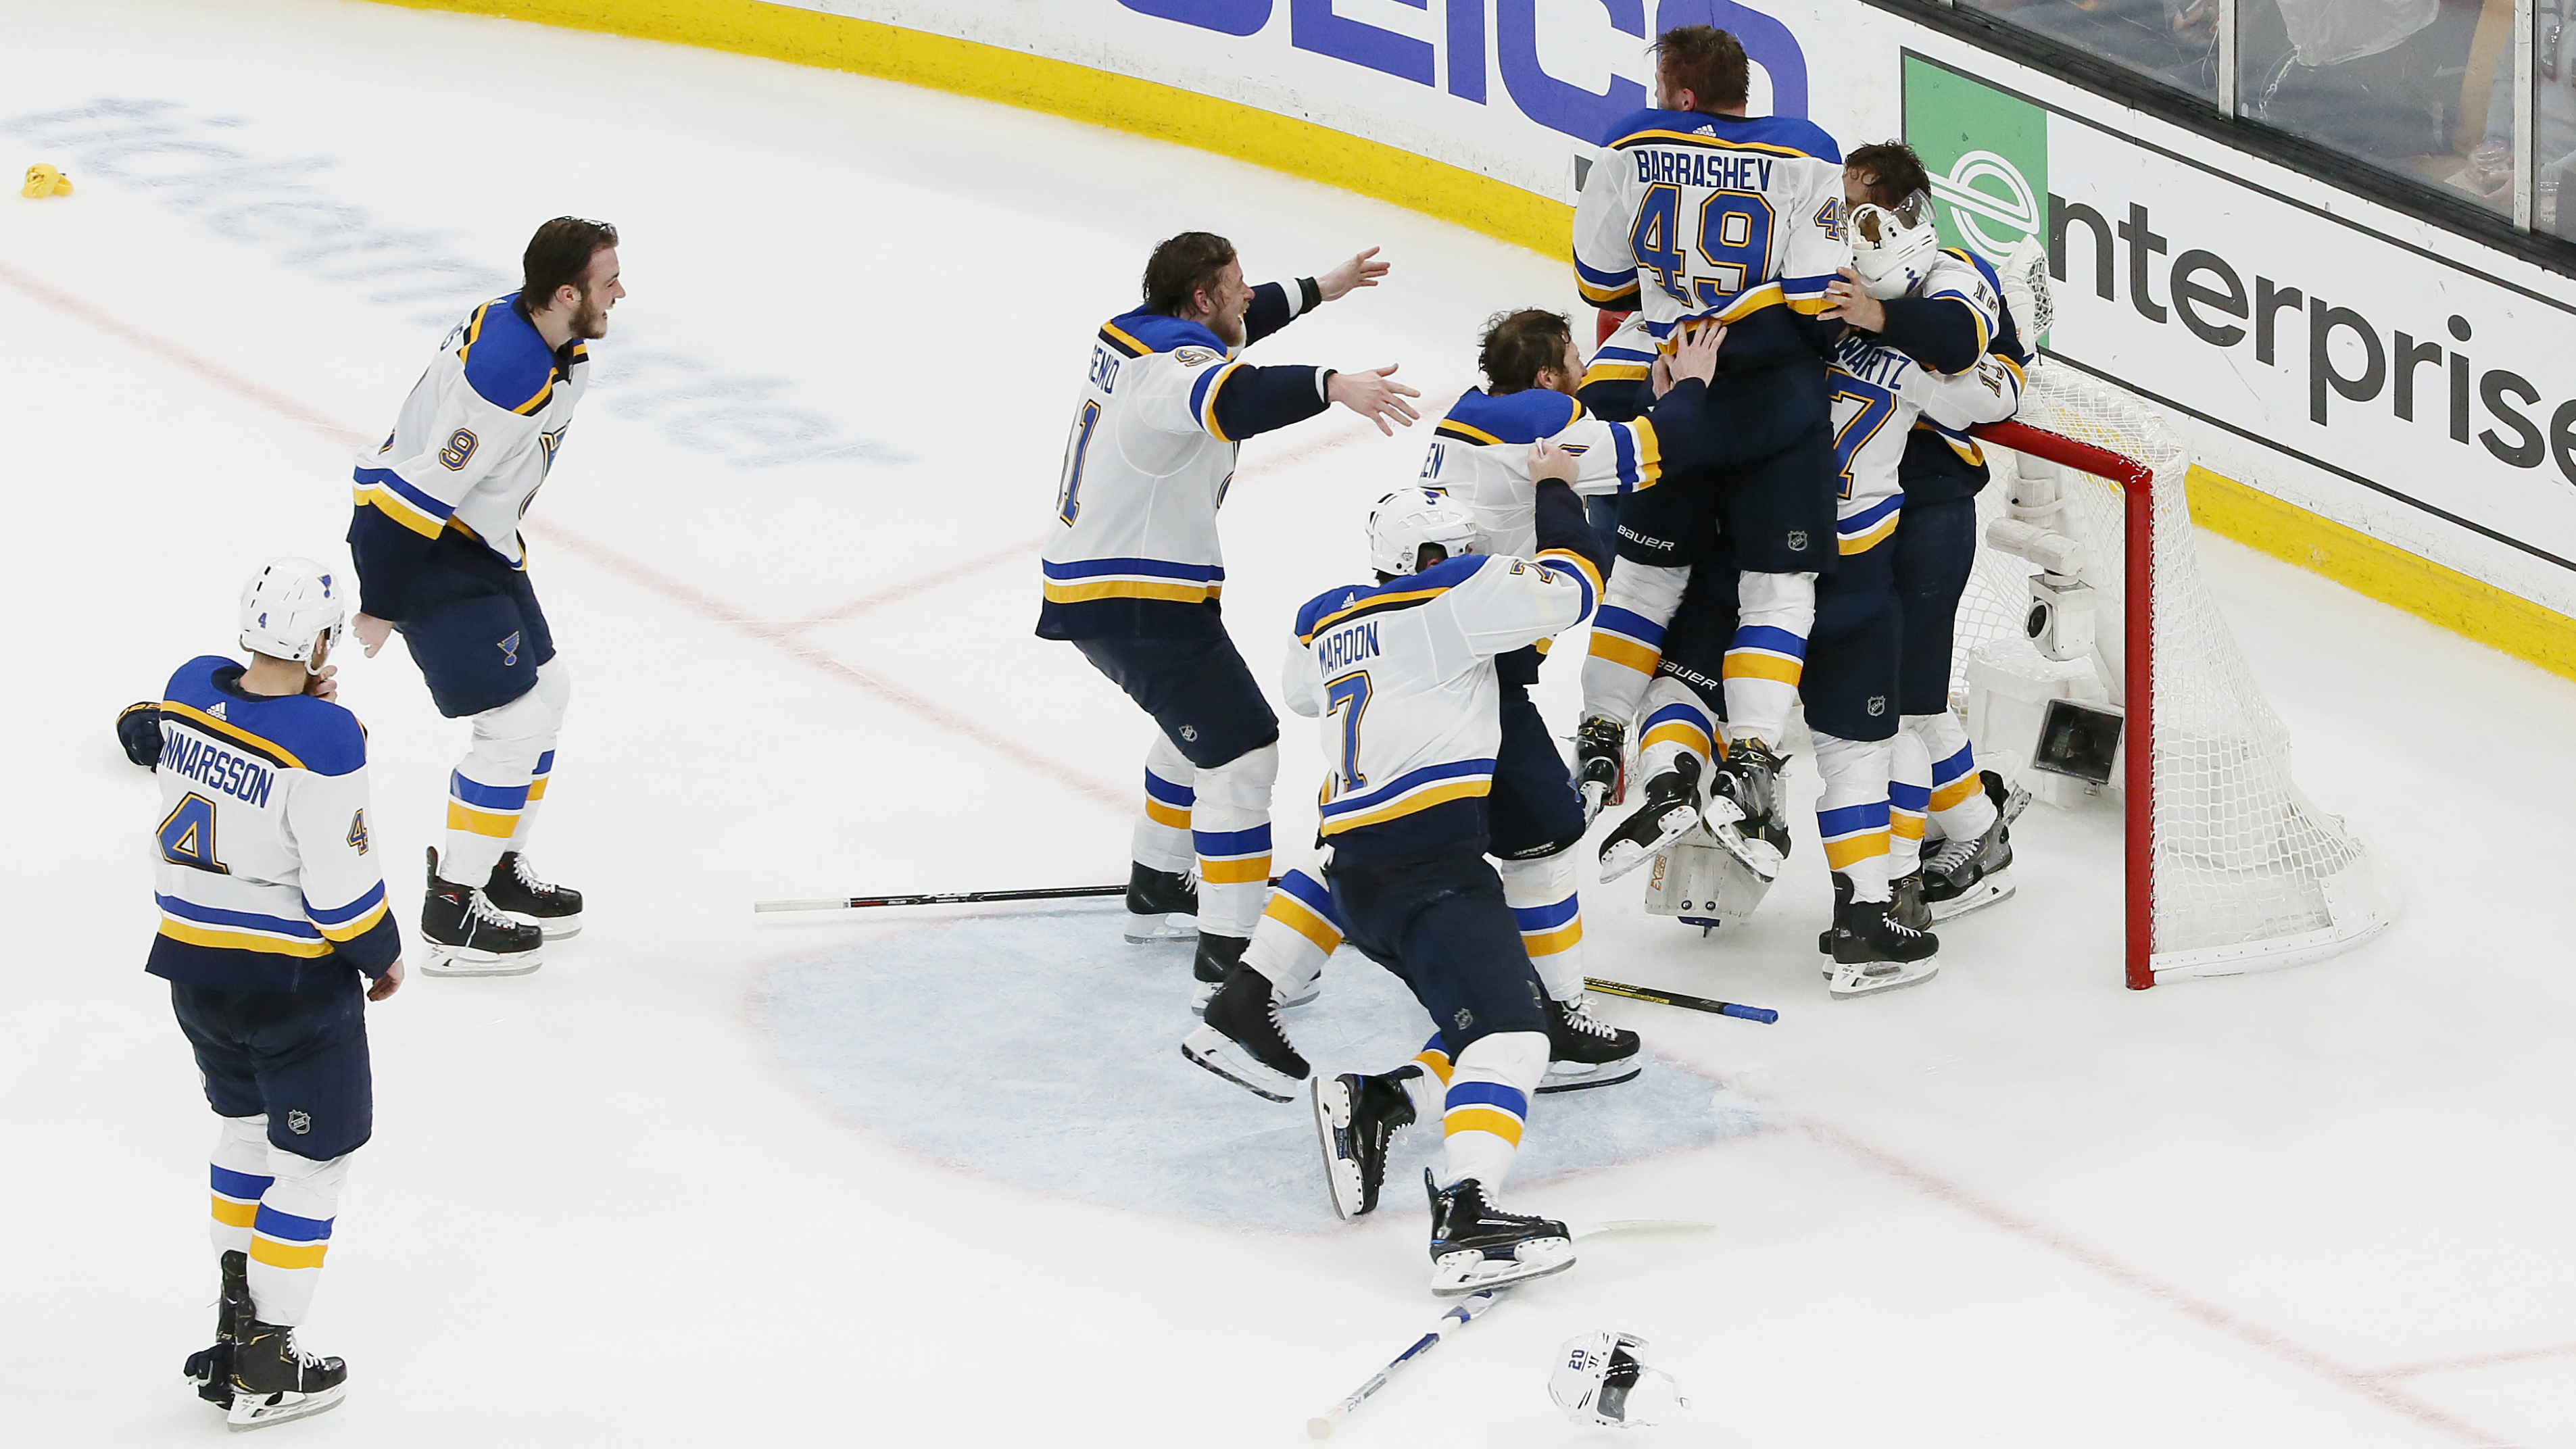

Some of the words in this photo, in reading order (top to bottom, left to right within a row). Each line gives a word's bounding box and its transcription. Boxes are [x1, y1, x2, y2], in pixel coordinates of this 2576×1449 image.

[1633, 149, 1773, 192] BARBASHEV
[1628, 181, 1776, 310] 49
[439, 427, 479, 471] 9
[258, 612, 268, 629] 4
[1318, 620, 1380, 679] MAROON
[1324, 669, 1374, 793] 7
[155, 791, 231, 875] 4
[346, 808, 369, 856] 4
[1568, 1349, 1586, 1371] 20
